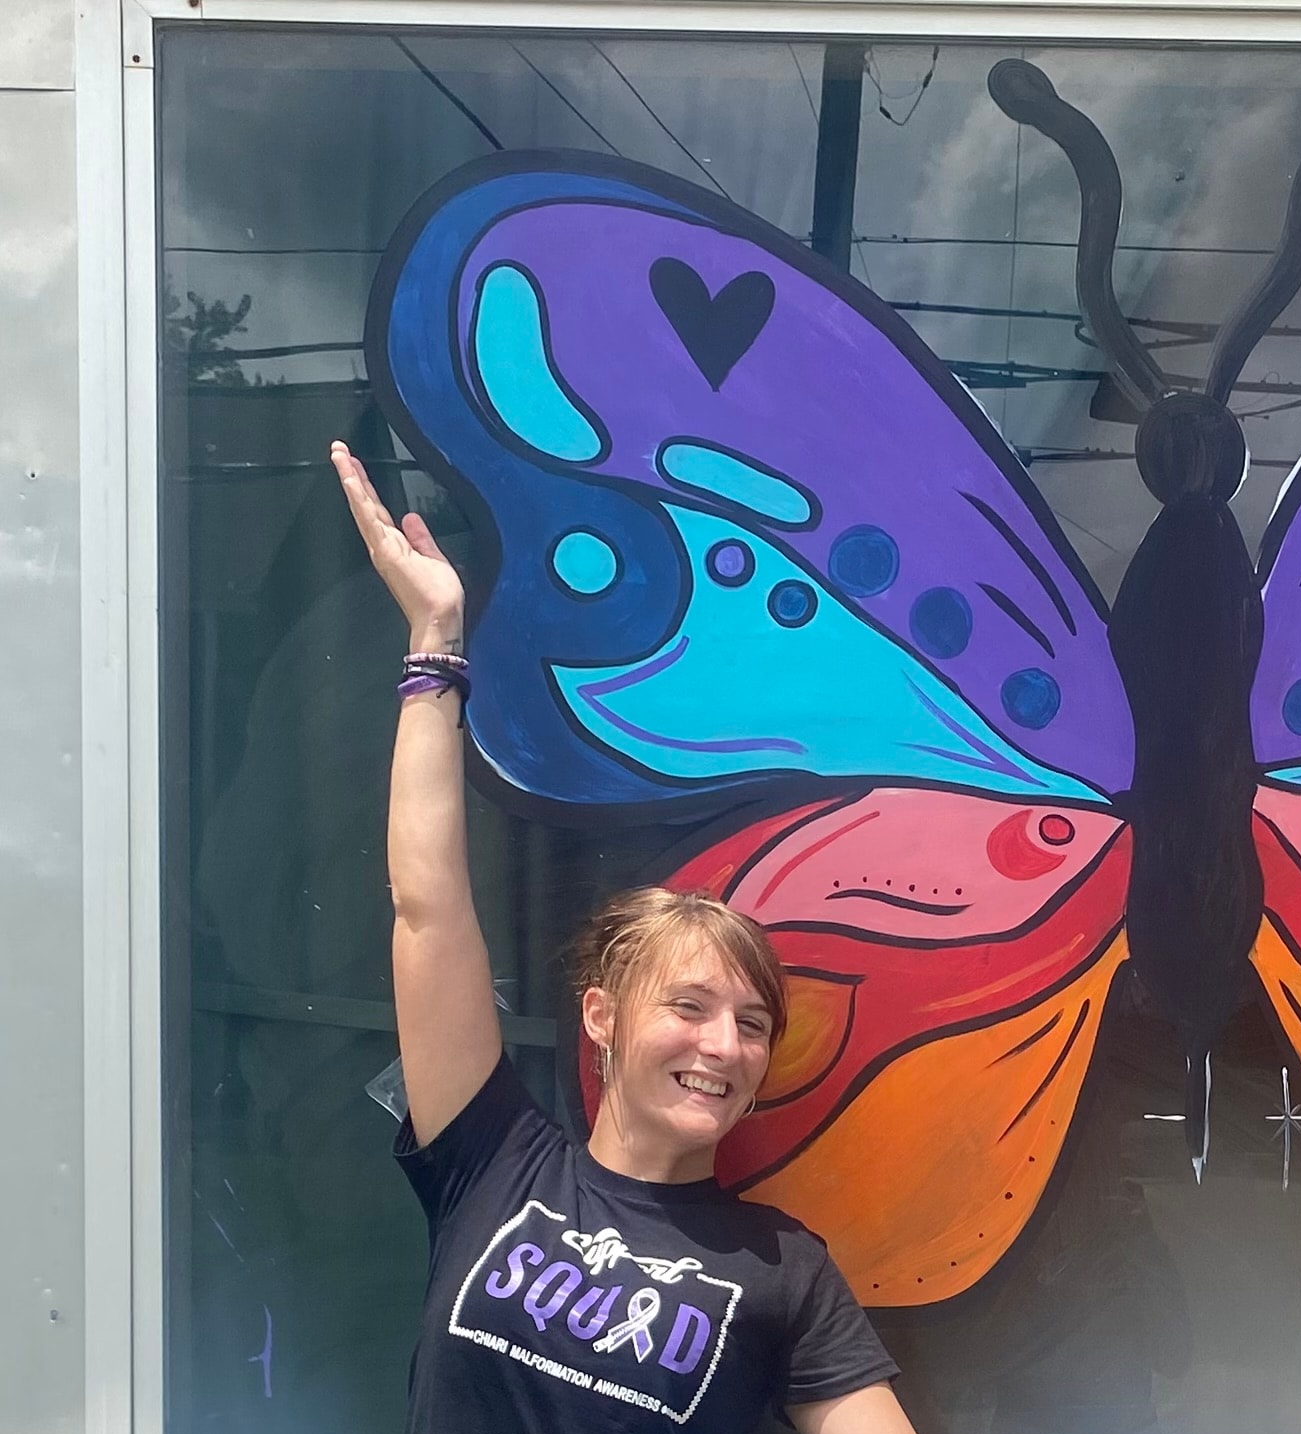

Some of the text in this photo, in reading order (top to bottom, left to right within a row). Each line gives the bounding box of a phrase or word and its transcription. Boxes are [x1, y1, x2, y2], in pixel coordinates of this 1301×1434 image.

[473, 1328, 661, 1413] CHIARI MALFORMATION AWARENESS
